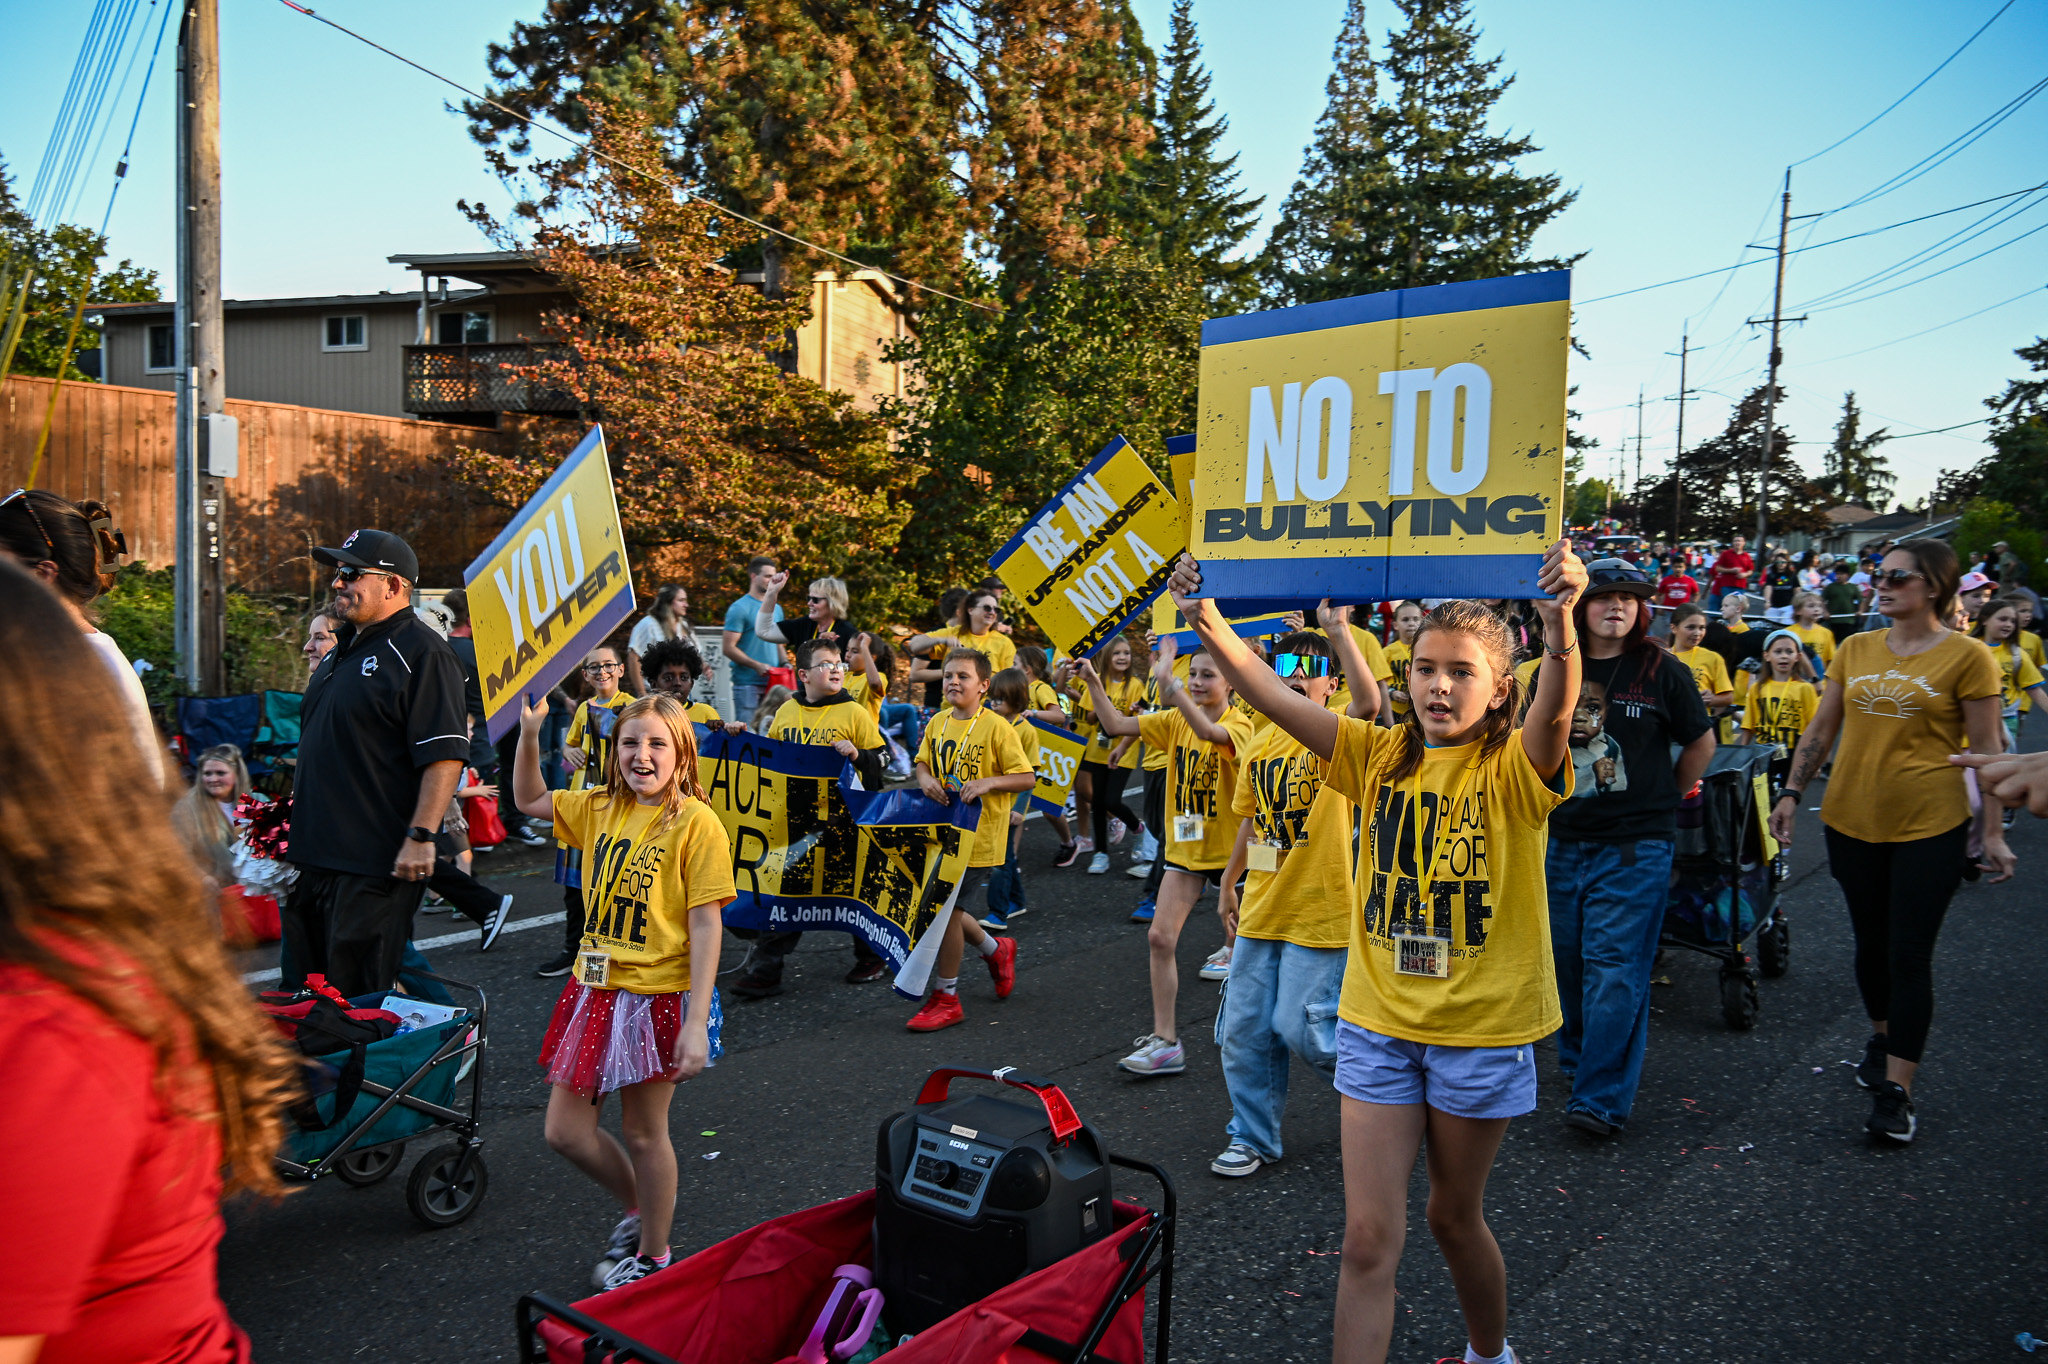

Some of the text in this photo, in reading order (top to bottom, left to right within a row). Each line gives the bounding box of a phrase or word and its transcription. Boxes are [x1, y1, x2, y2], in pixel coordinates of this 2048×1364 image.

[1245, 362, 1492, 503] NO TO
[1021, 472, 1119, 572] BE AN
[1203, 495, 1546, 543] BULLYING
[1025, 481, 1160, 607] UPSTANDER
[494, 492, 585, 653] YOU
[1064, 530, 1165, 627] NOT A
[486, 550, 622, 701] MATTER
[1068, 546, 1187, 660] BYSTANDE
[1614, 692, 1656, 706] WAYNE
[956, 762, 979, 782] OR
[1195, 770, 1218, 789] FOR
[1370, 785, 1438, 878] NO
[631, 843, 666, 873] LACE
[1434, 835, 1489, 877] FOR
[618, 868, 653, 902] FOR
[769, 905, 788, 922] At
[792, 905, 832, 922] John
[1364, 872, 1493, 947] HATE
[1401, 939, 1420, 956] NO
[949, 1139, 970, 1150] ION
